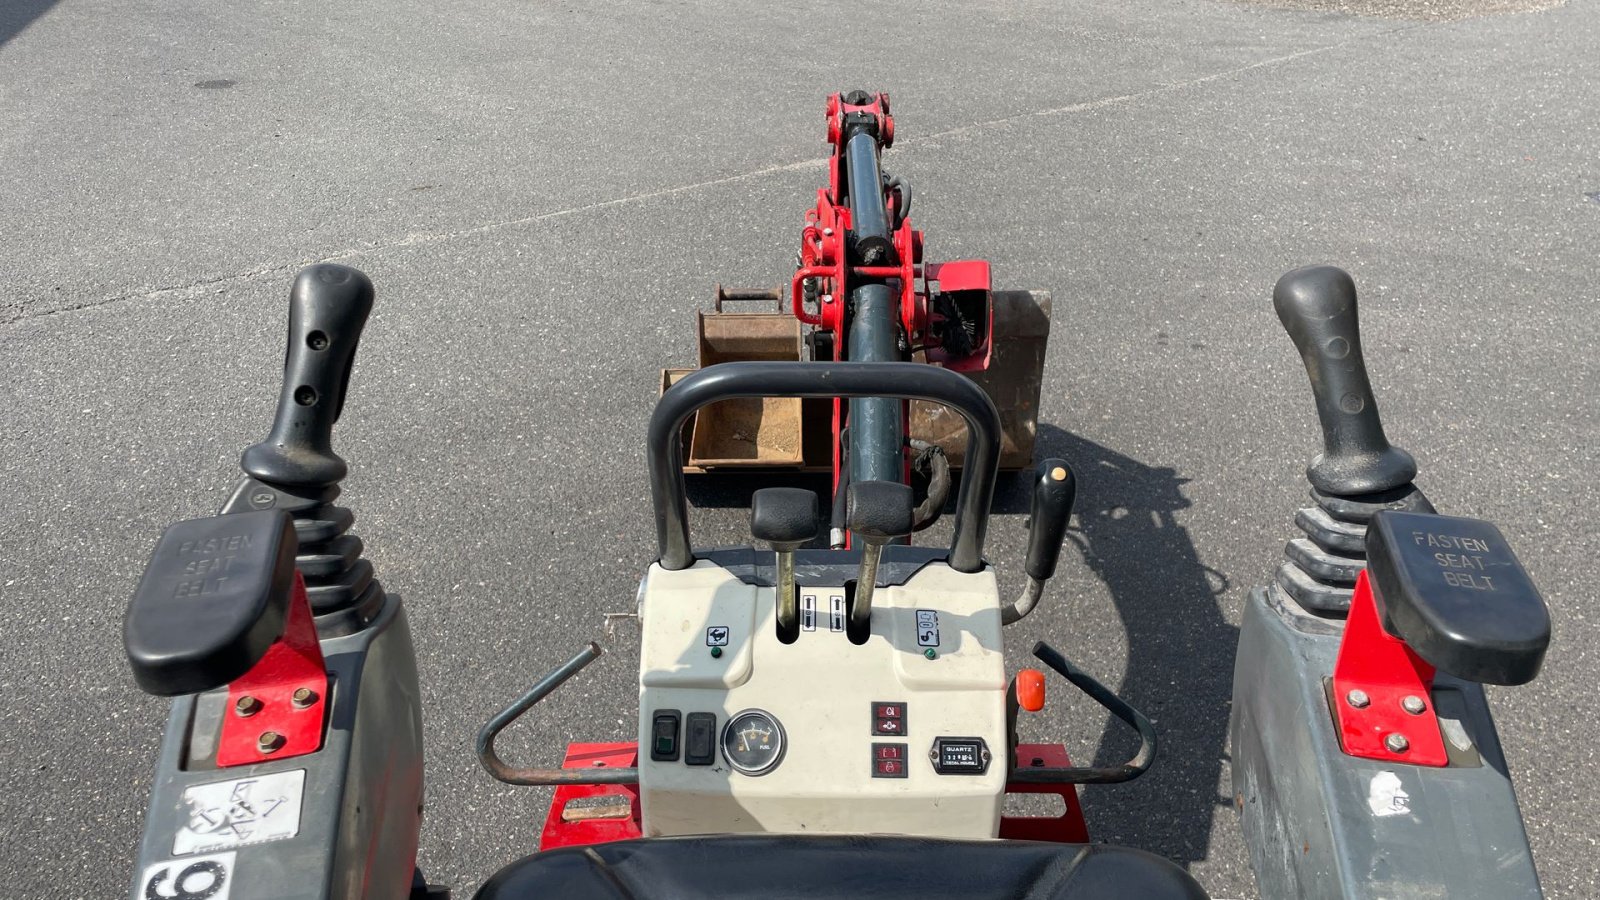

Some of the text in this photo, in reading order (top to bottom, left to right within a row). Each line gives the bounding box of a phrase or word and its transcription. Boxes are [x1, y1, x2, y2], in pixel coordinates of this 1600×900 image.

[177, 534, 253, 557] FASTEN
[1412, 531, 1490, 553] FASTEN
[183, 556, 236, 577] SEAT
[1435, 552, 1485, 571] SEAT
[173, 577, 229, 599] BELT
[1442, 571, 1497, 591] BELT
